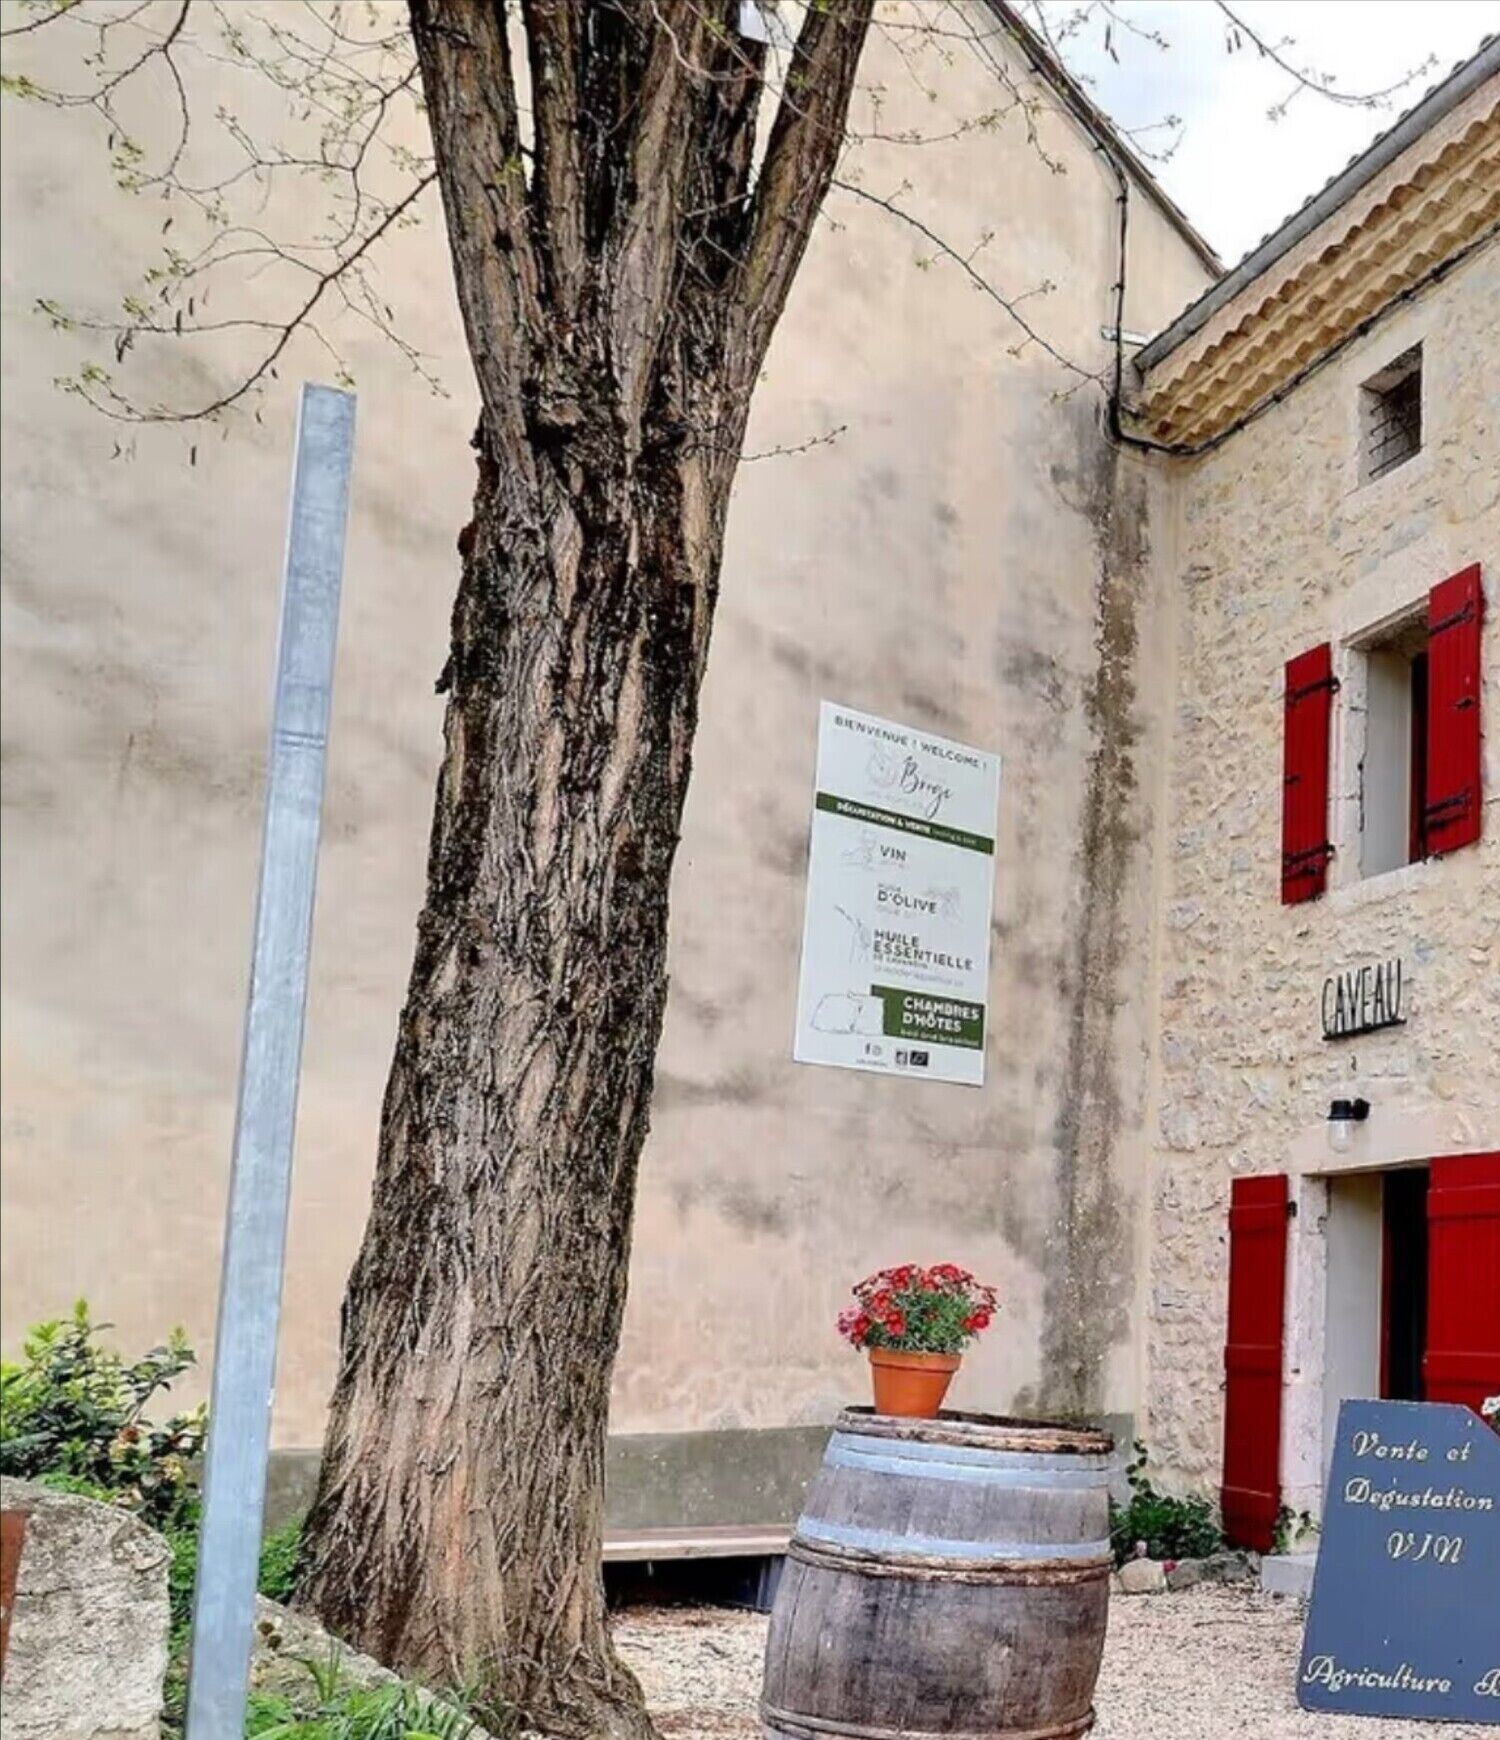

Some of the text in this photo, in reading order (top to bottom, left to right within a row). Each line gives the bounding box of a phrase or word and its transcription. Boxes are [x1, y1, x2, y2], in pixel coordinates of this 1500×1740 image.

[834, 714, 908, 746] BIENVENUE
[921, 741, 979, 769] WELCOME
[880, 844, 907, 862] VIN
[877, 889, 938, 914] D'OLIVE
[873, 928, 919, 947] HUILE
[873, 940, 974, 971] ESSENTIELLE
[902, 996, 980, 1021] CHAMBRES
[1321, 958, 1402, 1037] CAVEAU
[902, 1011, 962, 1033] D'HÔTES
[1352, 1430, 1472, 1461] Vente et
[1387, 1530, 1464, 1564] VIN
[1302, 1655, 1452, 1694] Agriculture
